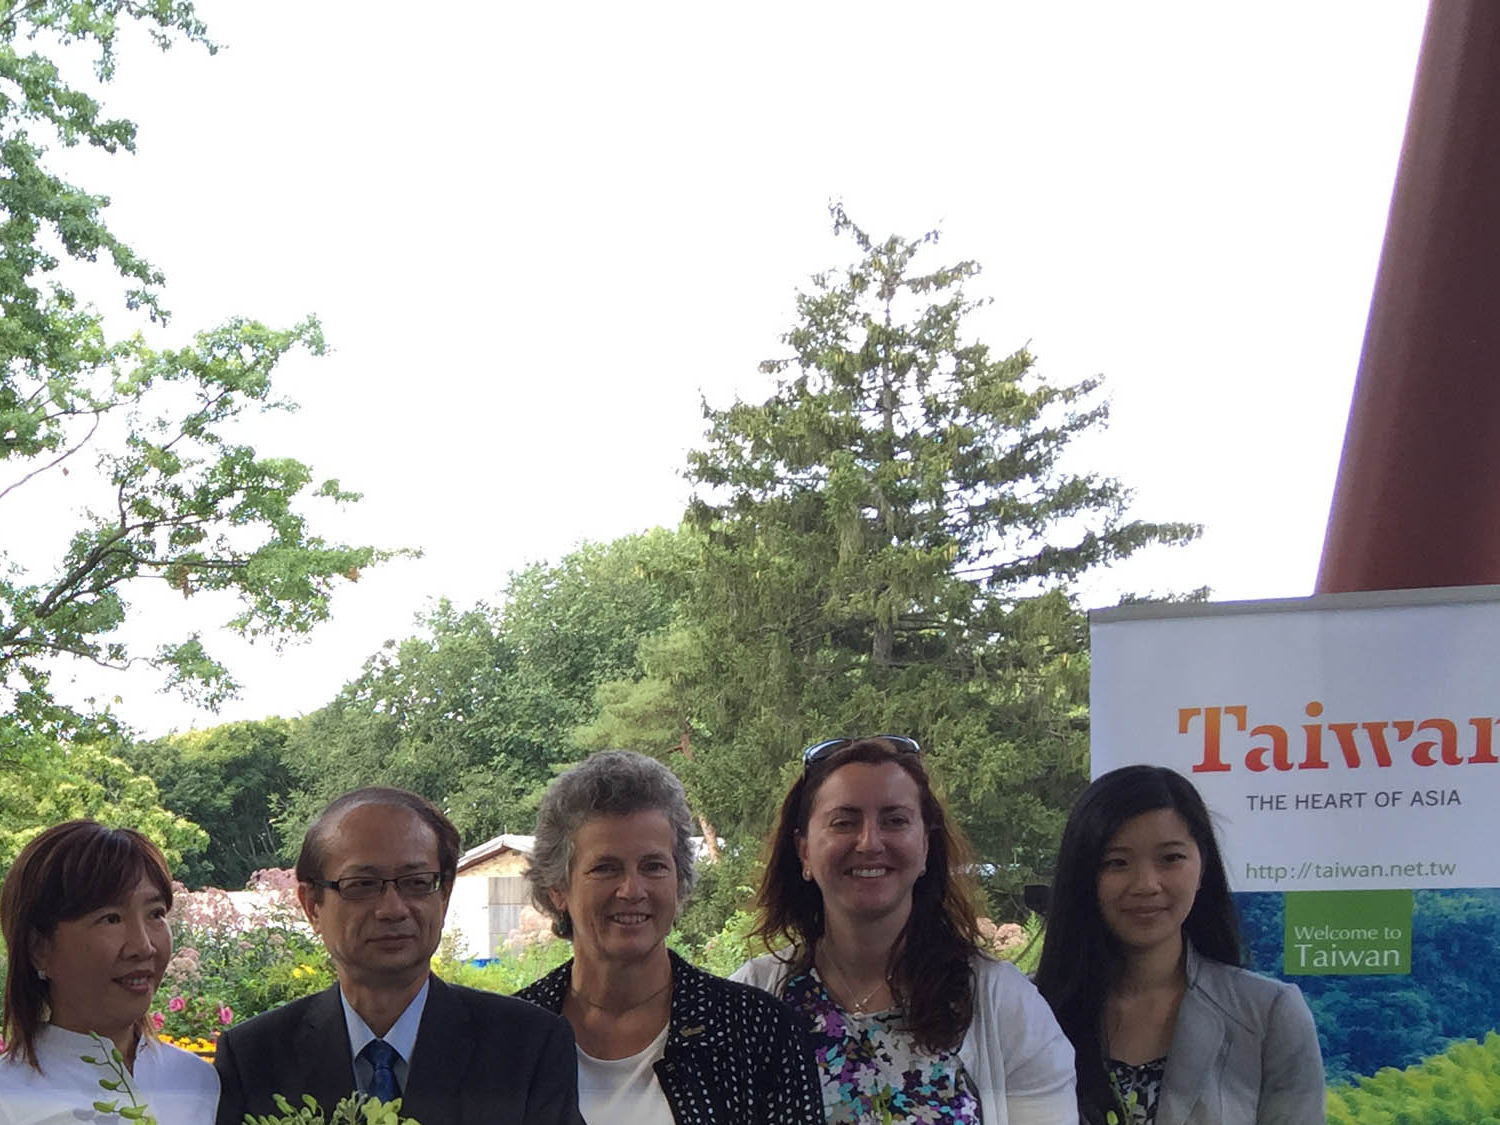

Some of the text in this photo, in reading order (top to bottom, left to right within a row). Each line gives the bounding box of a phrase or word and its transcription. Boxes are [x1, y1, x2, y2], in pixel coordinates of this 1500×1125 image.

[1246, 790, 1462, 811] THE HEART OF ASIA
[1245, 861, 1457, 883] http://taiwan.net.tw
[1294, 925, 1402, 940] Welcome to
[1294, 944, 1401, 968] Taiwan
